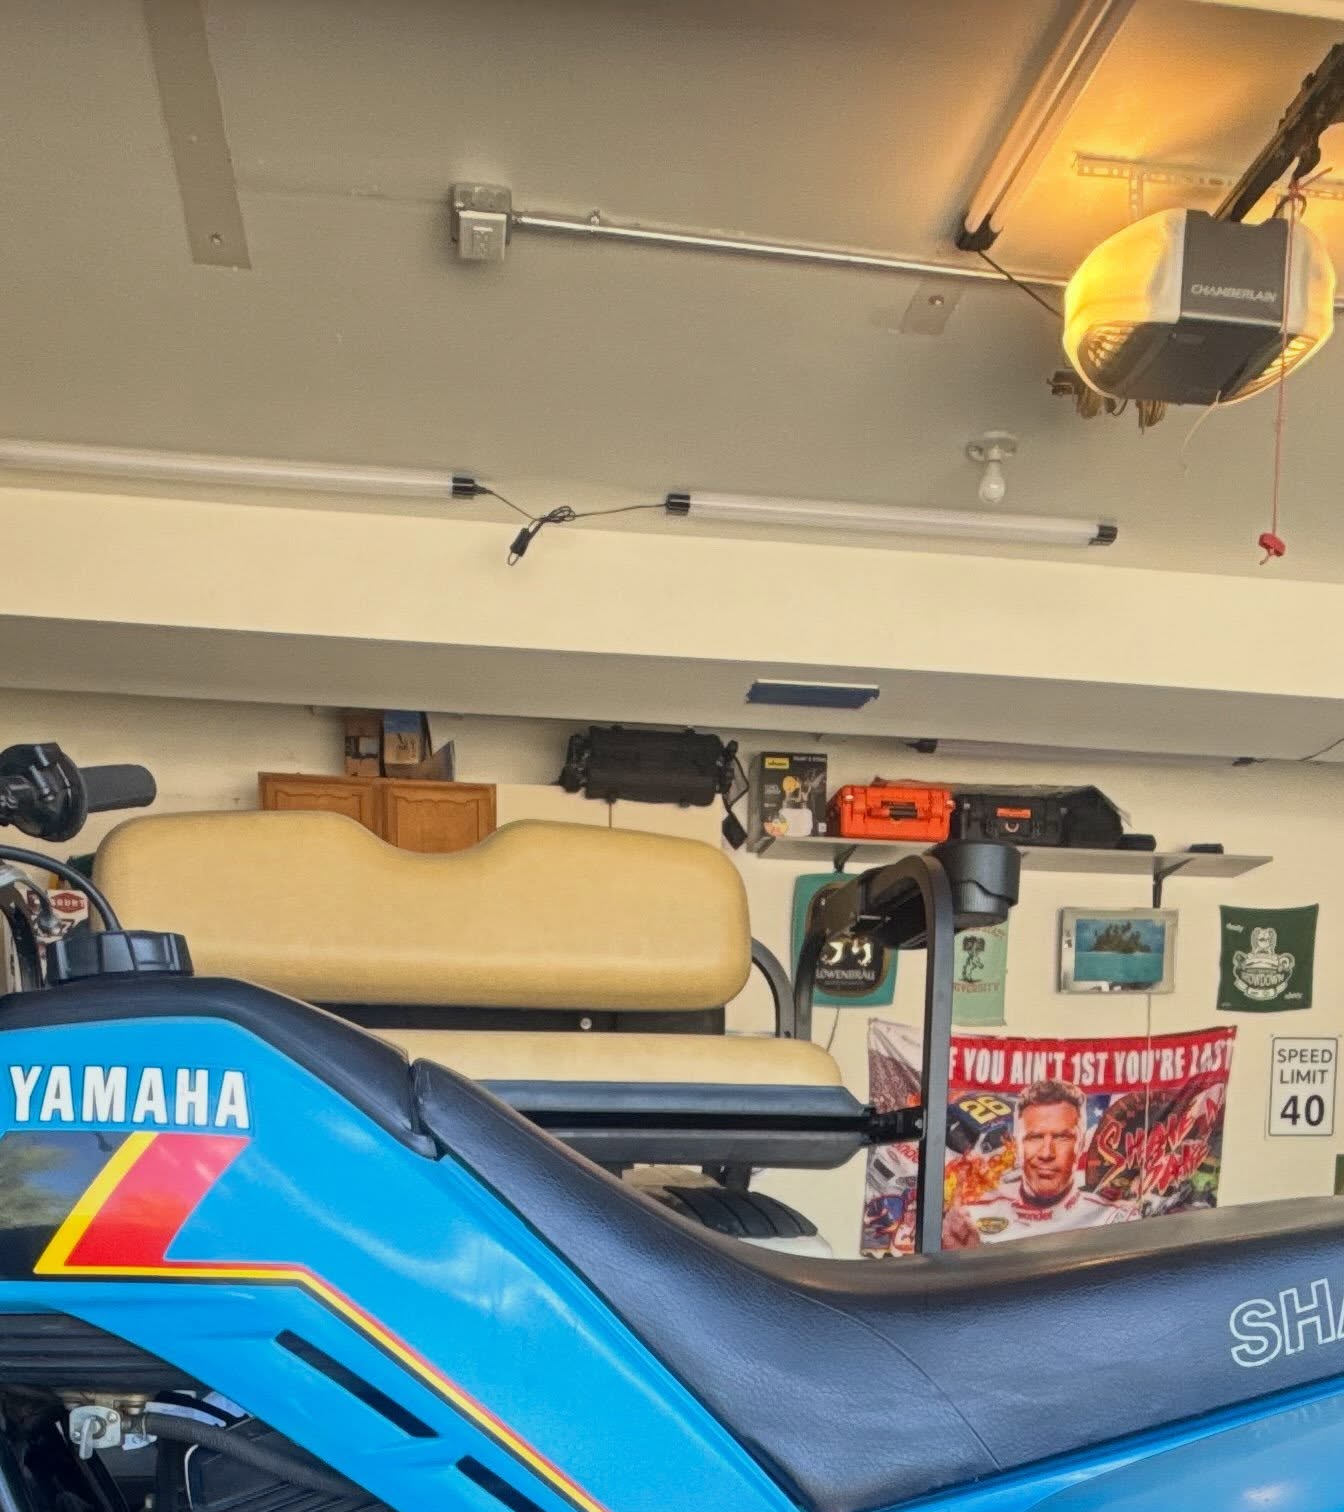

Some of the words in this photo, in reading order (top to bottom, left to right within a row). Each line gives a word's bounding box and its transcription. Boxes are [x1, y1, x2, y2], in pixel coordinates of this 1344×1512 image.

[1190, 283, 1277, 303] CHAMBERLAIN
[963, 1046, 1005, 1084] YOU
[1010, 1046, 1067, 1085] AIN'T
[1071, 1051, 1109, 1086] 1ST
[1114, 1045, 1186, 1083] YOU'RE
[1188, 1037, 1234, 1074] LAST
[1276, 1047, 1333, 1064] SPEED
[1278, 1068, 1329, 1085] LIMIT
[8, 1064, 251, 1130] YAMAHA
[1279, 1094, 1325, 1127] 40
